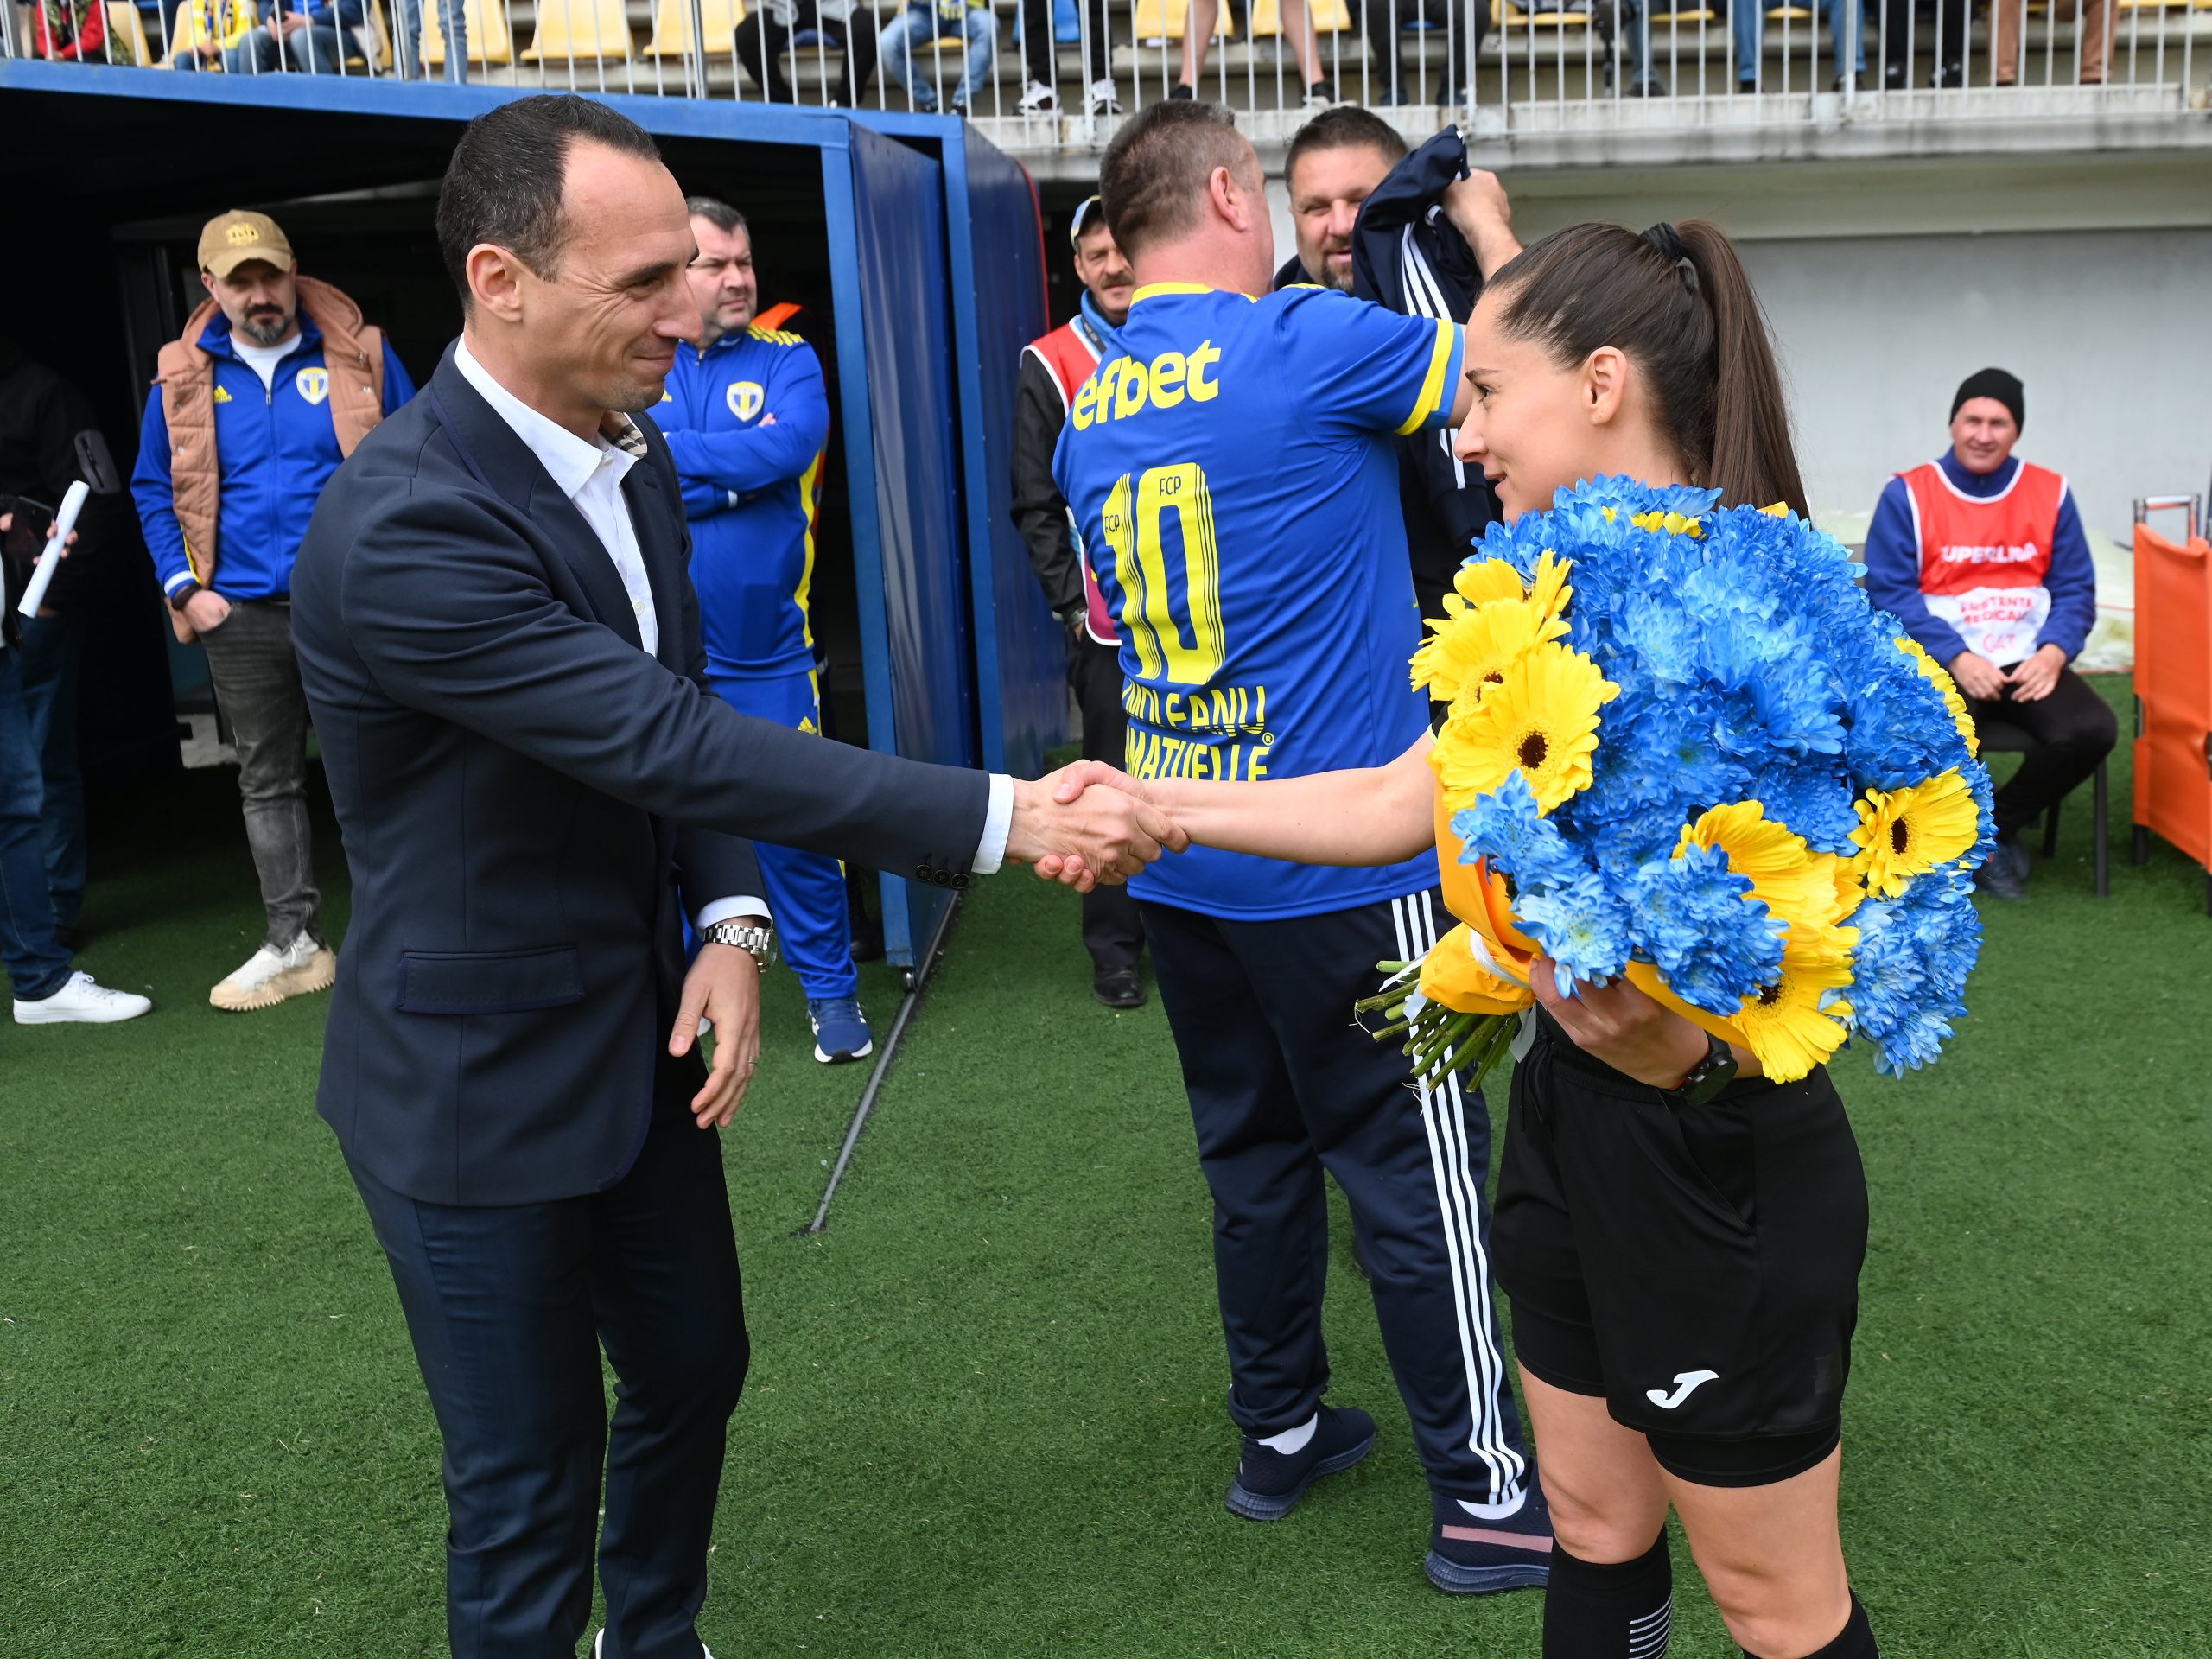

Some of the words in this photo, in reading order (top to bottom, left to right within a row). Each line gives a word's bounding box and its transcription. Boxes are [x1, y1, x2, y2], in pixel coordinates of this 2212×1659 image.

[1072, 339, 1222, 431] efbet
[1159, 475, 1182, 497] FCP
[1104, 514, 1121, 533] FCP
[1102, 461, 1225, 685] 10
